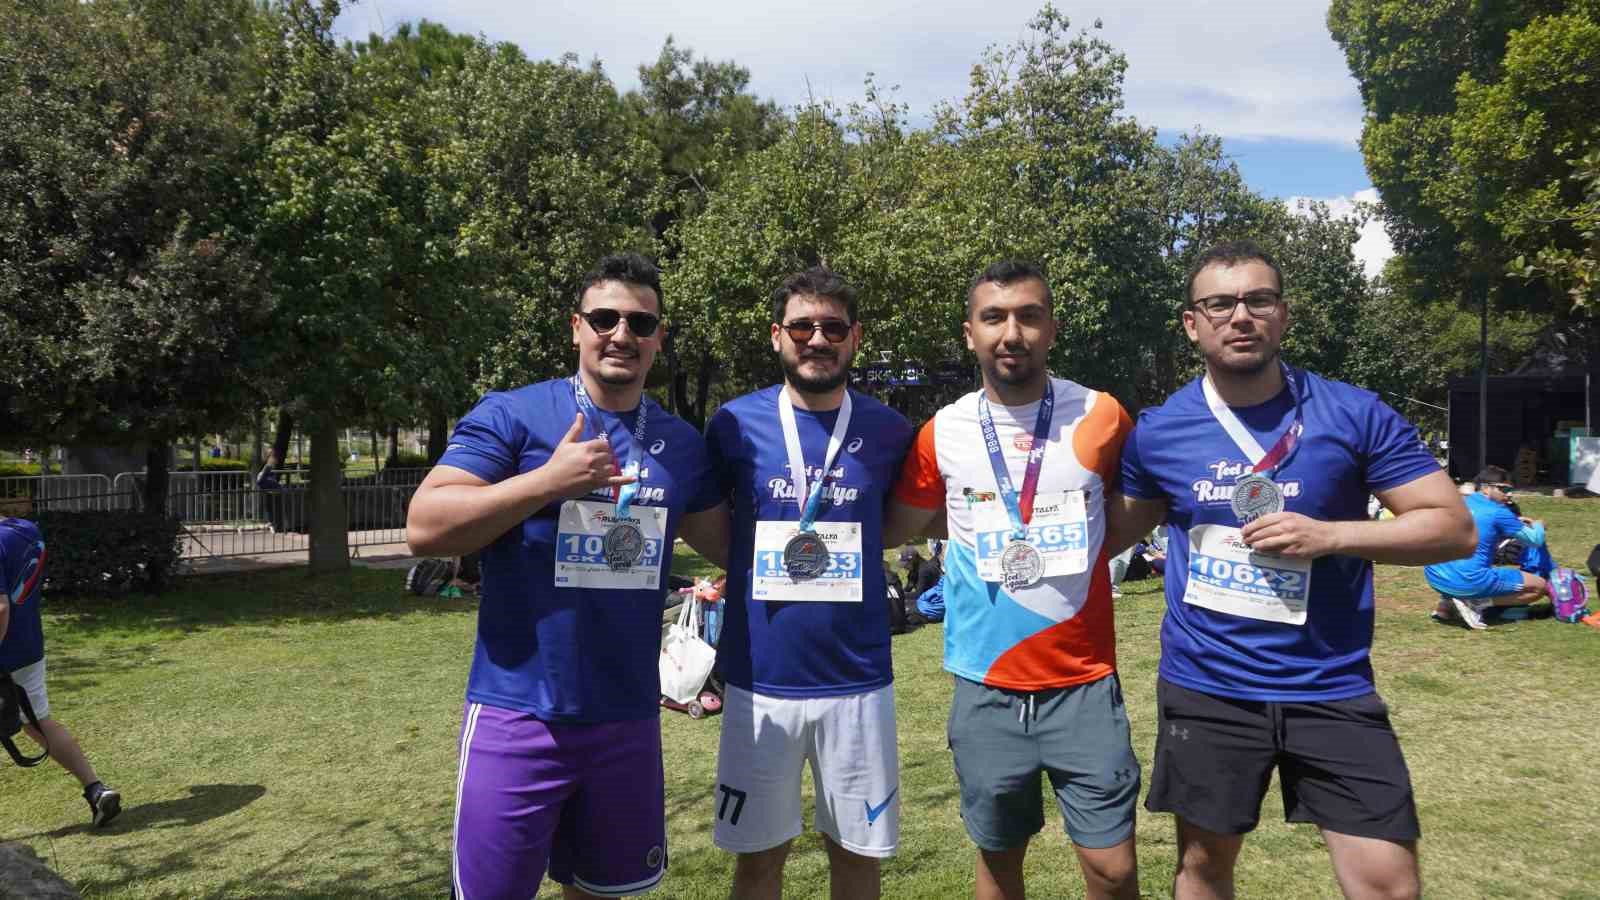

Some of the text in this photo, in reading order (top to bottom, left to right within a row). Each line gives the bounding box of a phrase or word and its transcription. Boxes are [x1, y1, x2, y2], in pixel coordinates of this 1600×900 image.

[1209, 461, 1241, 480] feel
[565, 535, 657, 558] 103
[1195, 557, 1301, 591] 10622
[1198, 574, 1222, 586] CK
[719, 783, 747, 826] 77
